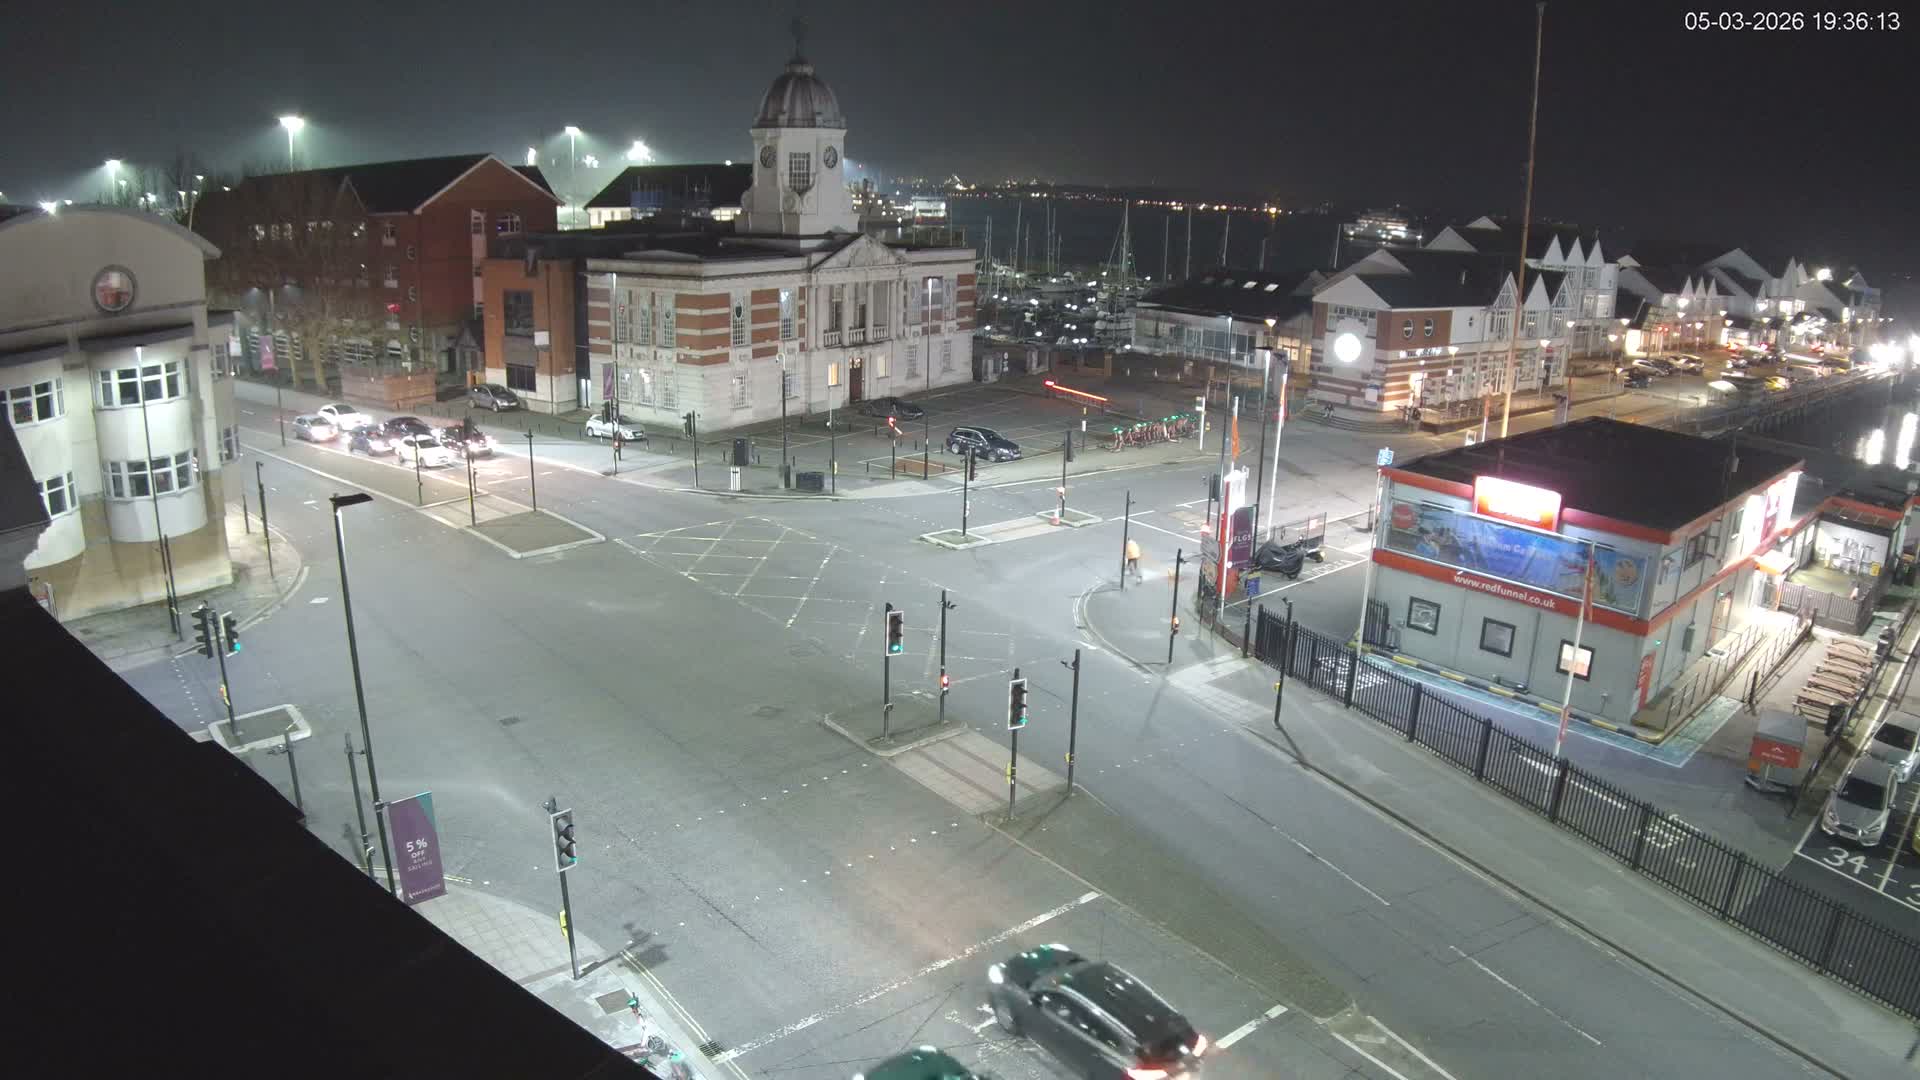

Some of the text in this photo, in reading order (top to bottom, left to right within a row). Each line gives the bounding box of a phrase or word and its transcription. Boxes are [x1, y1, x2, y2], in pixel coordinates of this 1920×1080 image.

[1454, 575, 1556, 608] www.redfunnel.co.uk
[411, 850, 425, 859] OFF
[1823, 846, 1869, 875] 34
